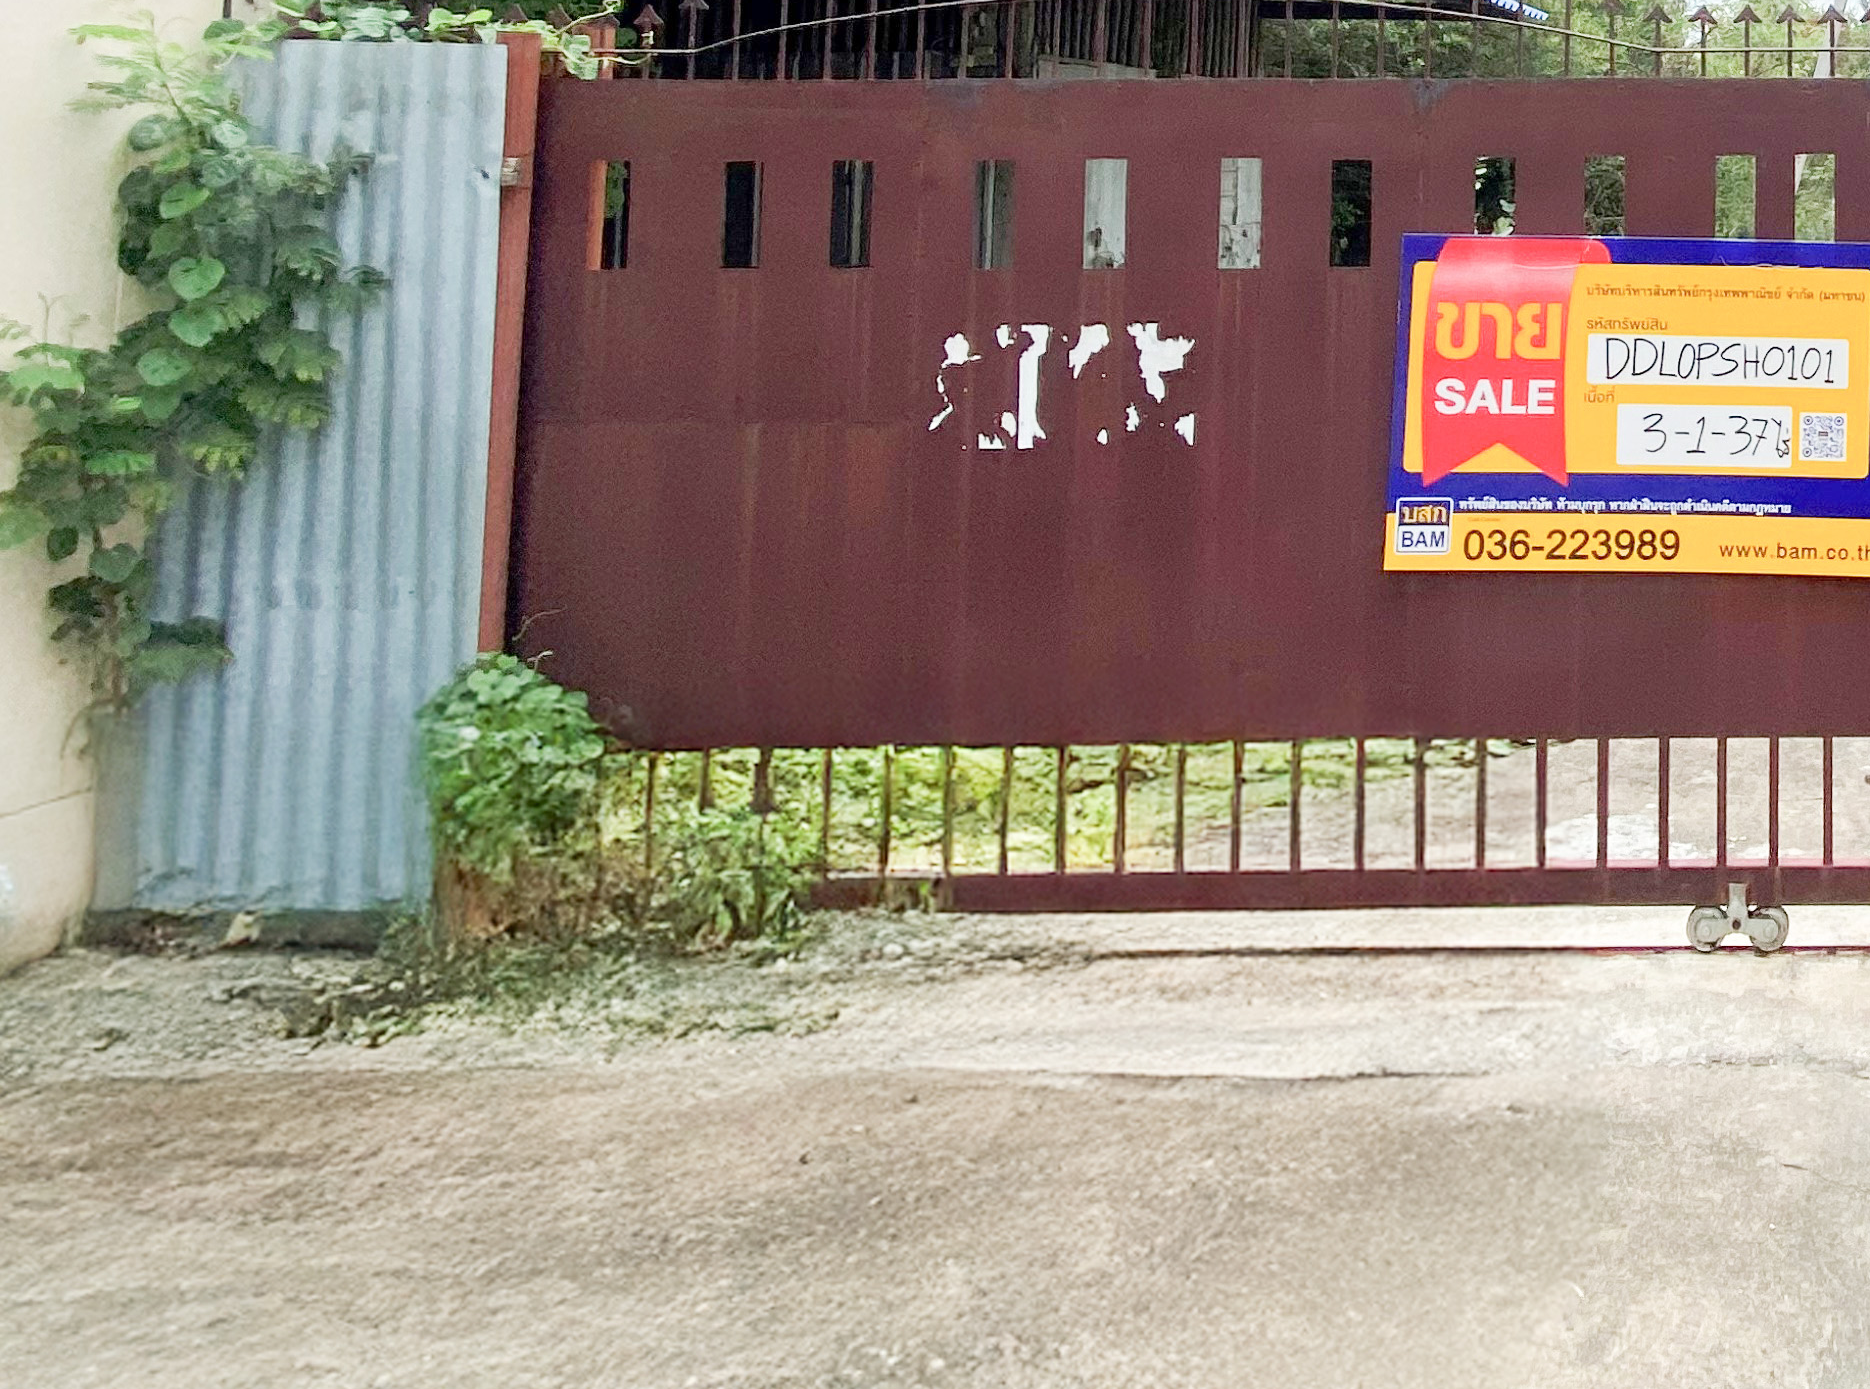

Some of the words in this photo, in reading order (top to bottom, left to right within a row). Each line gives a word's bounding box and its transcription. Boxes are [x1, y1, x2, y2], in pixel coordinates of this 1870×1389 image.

[1786, 287, 1814, 301] จำกัด
[1818, 290, 1866, 303] (มหาชน)
[1434, 301, 1561, 361] ขาย
[1586, 317, 1668, 331] รหัสทรัพย์สิน
[1434, 377, 1556, 415] SALE
[1401, 503, 1447, 523] บสก
[1401, 530, 1445, 548] BAM
[1463, 528, 1681, 562] 036-223989
